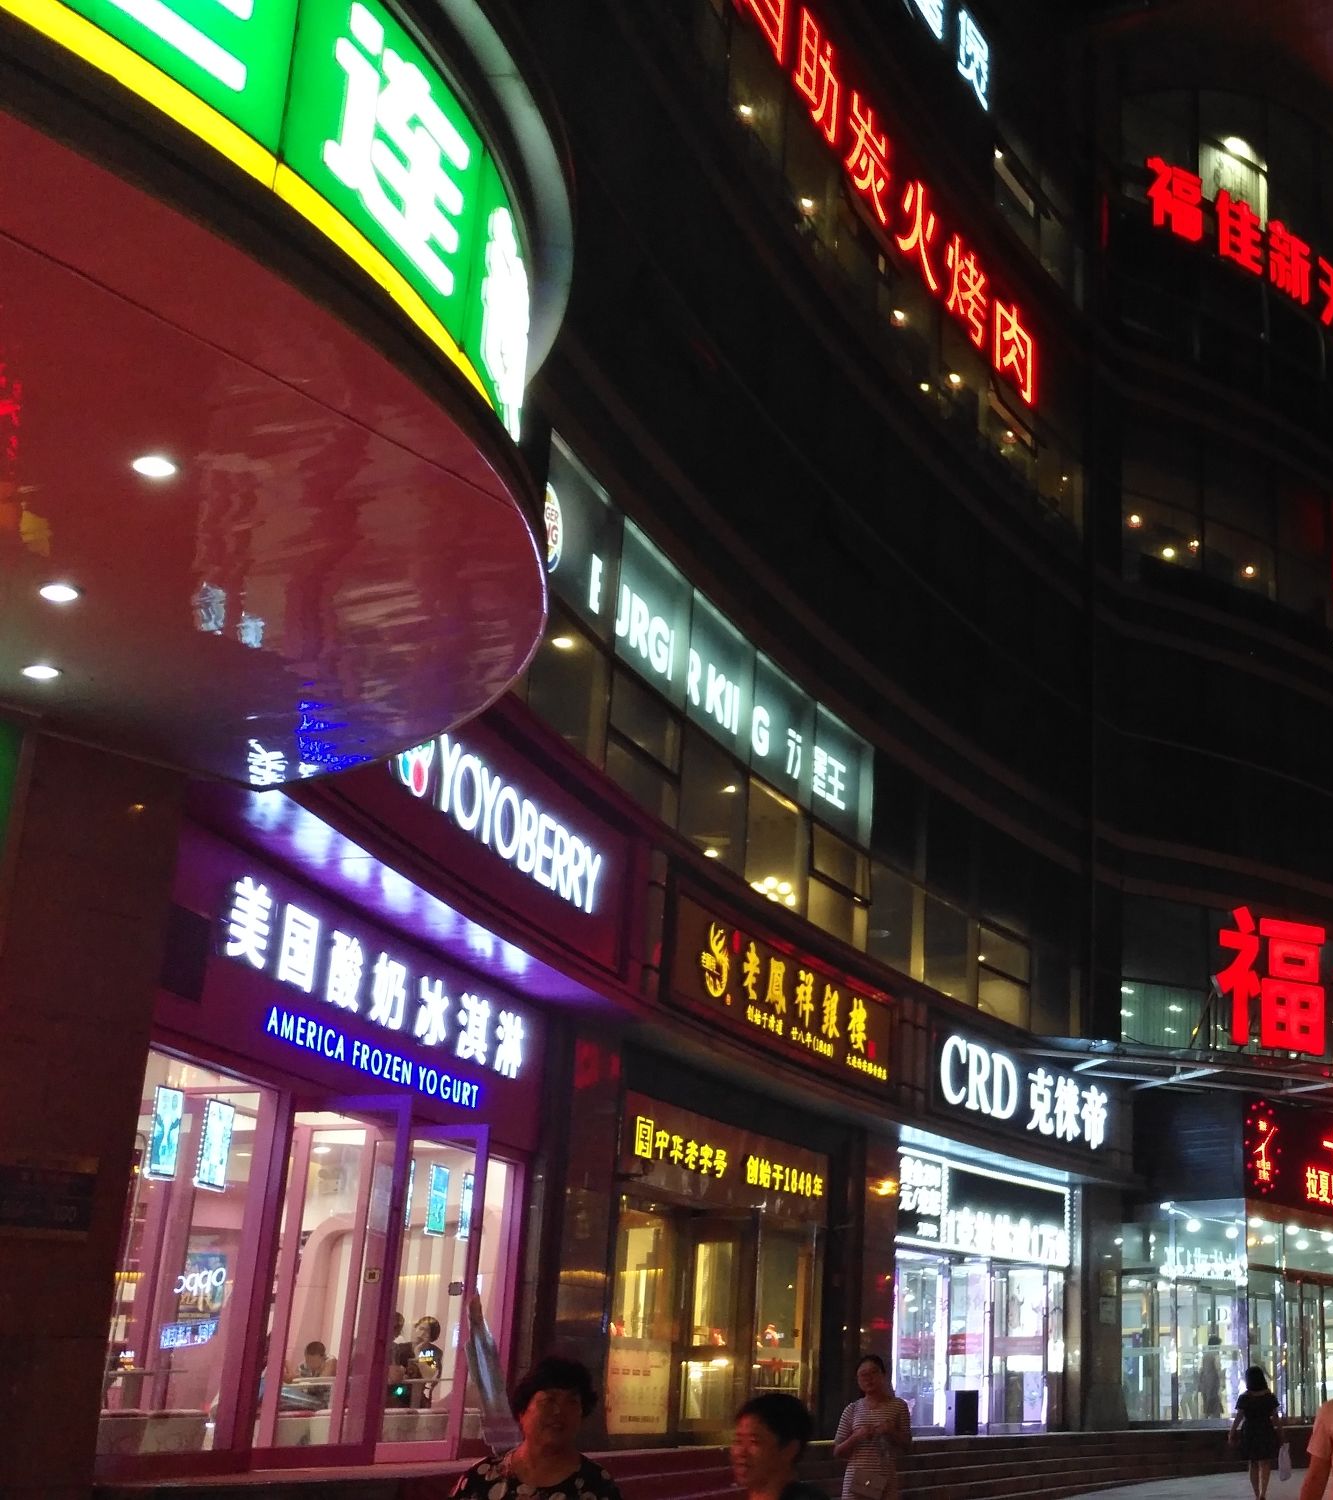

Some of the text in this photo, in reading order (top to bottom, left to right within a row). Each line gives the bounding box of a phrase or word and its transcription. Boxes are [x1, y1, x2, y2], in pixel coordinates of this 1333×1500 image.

[439, 732, 602, 914] YOYOBERRY
[226, 875, 525, 1080] 美国酸奶冰淇淋
[266, 1006, 479, 1109] AMERICA FROZEN YOGURT
[940, 1035, 1018, 1120] CRD
[655, 1129, 824, 1197] 中华老字号 创始于1848年
